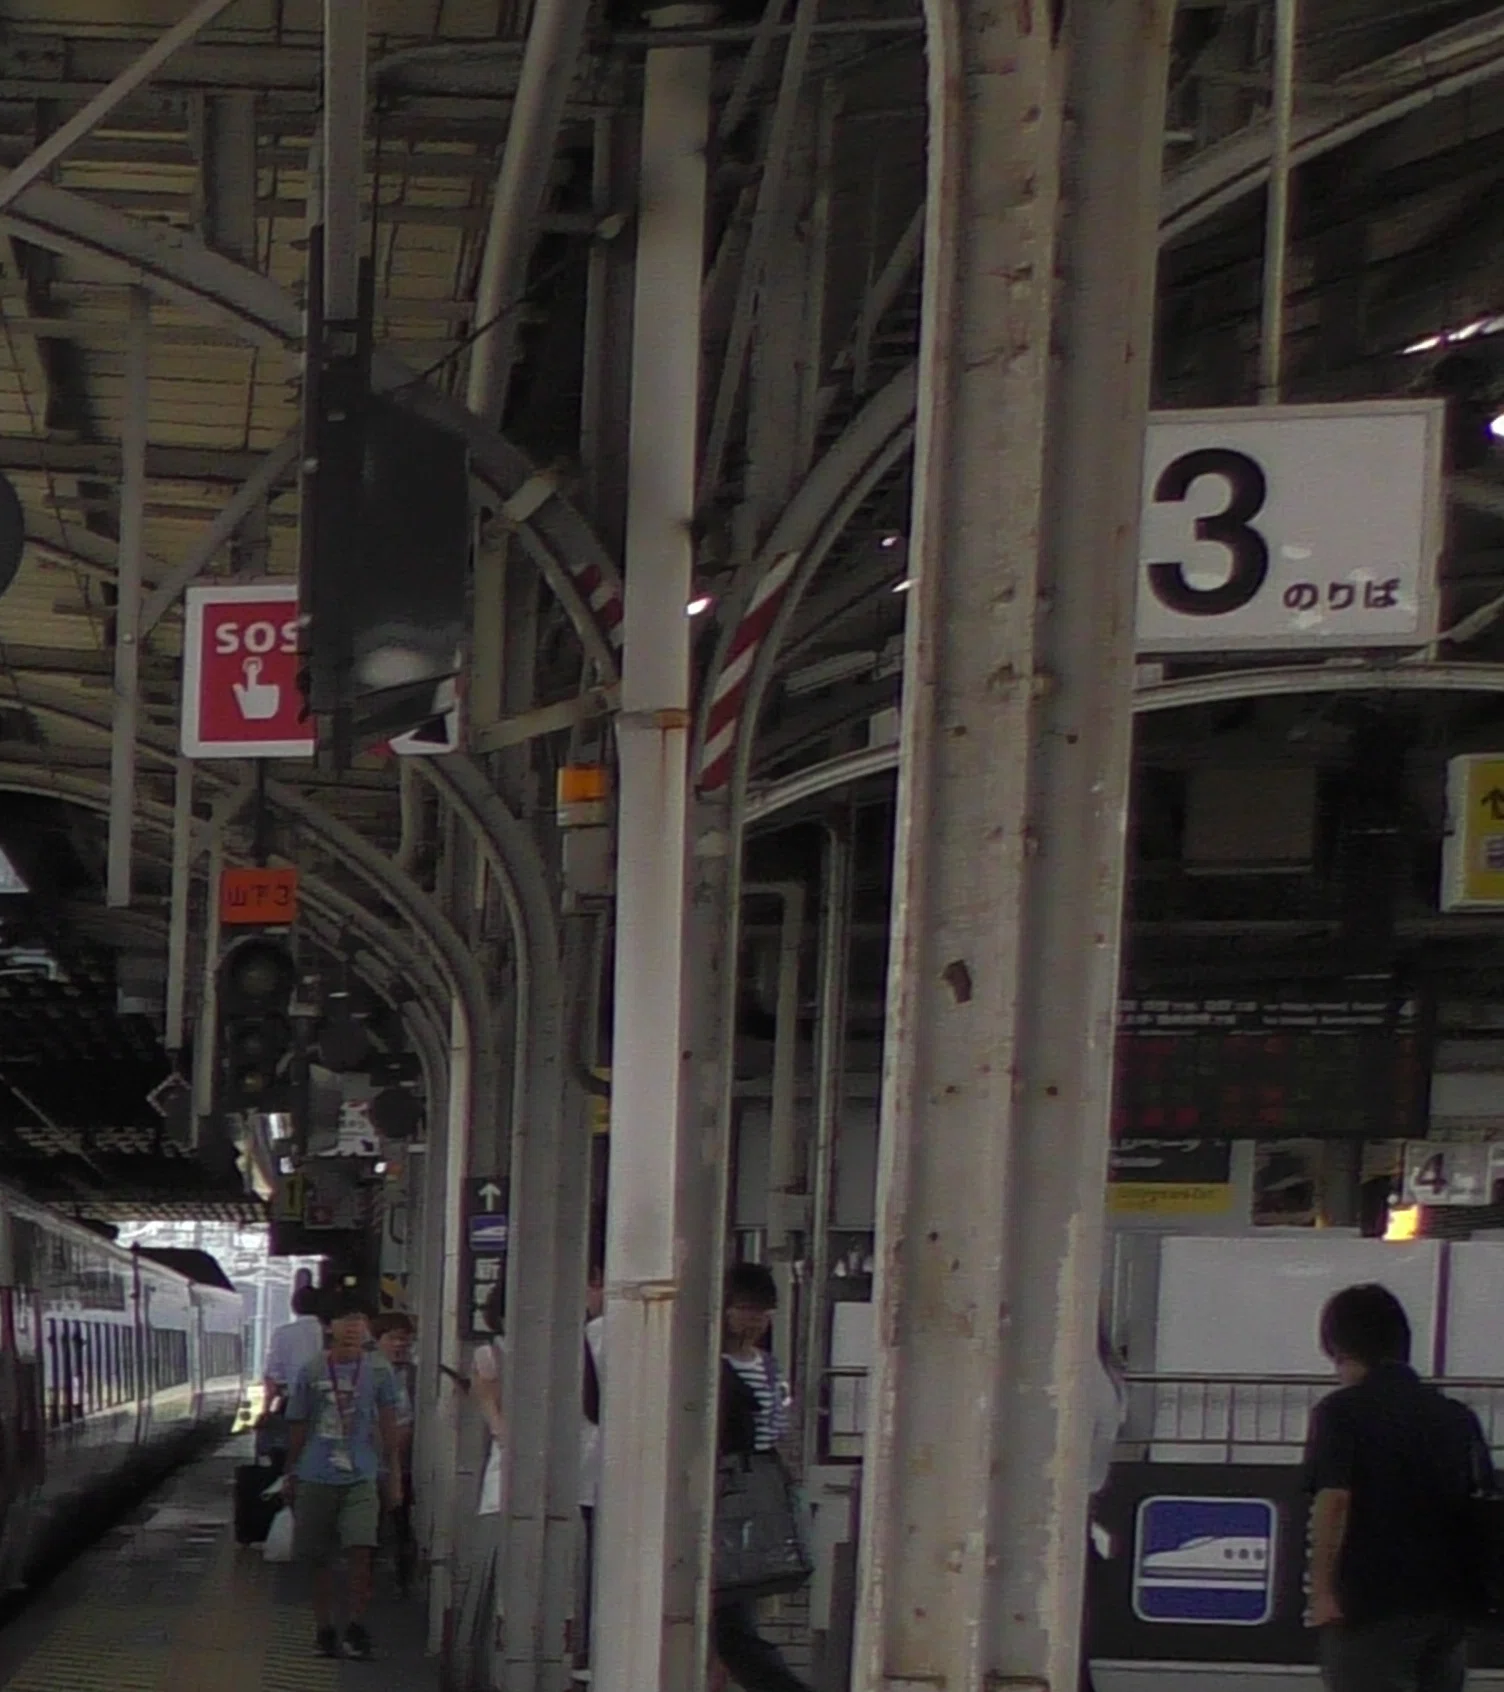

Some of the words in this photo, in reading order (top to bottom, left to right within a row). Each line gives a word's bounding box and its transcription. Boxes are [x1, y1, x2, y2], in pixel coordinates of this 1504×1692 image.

[1146, 447, 1270, 617] 3
[1282, 576, 1402, 611] のりば
[214, 620, 299, 655] SOS
